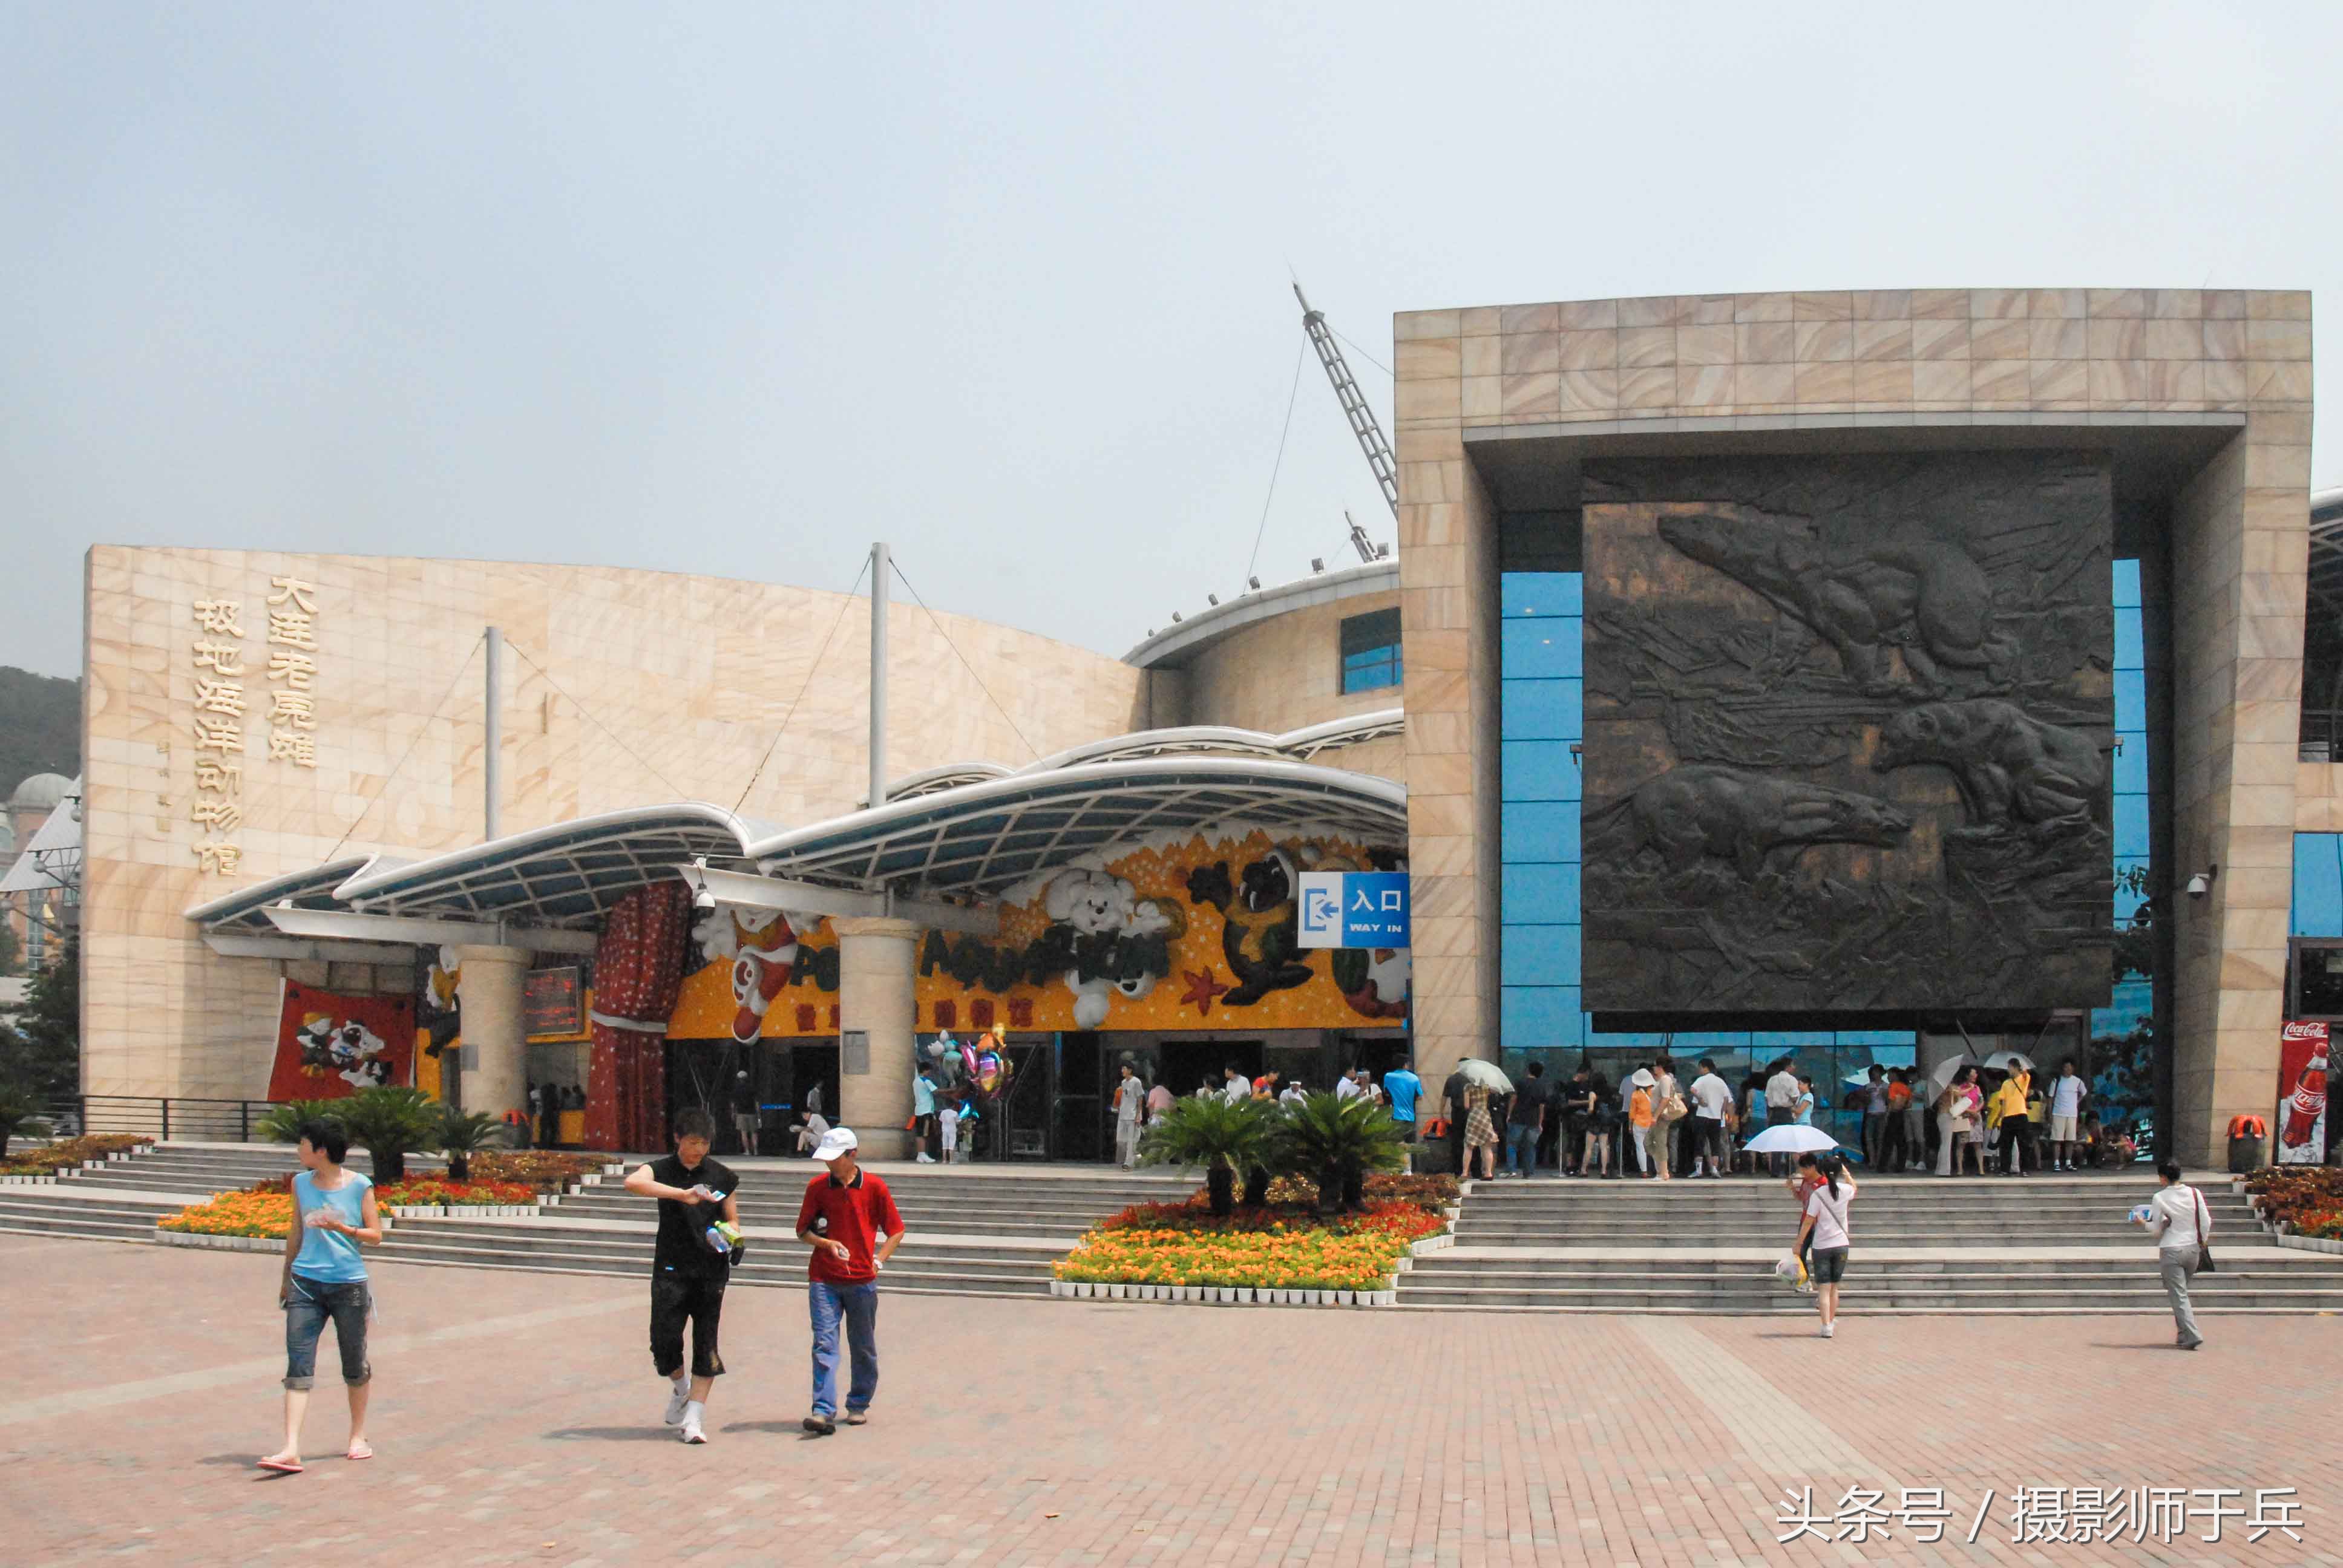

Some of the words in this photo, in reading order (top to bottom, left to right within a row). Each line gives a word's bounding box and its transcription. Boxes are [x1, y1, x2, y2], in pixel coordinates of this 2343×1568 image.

[267, 575, 320, 769] 大连老虎滩
[191, 596, 247, 877] 极地海洋动物馆
[1349, 923, 1380, 932] WAY
[1387, 924, 1402, 933] IN
[1351, 889, 1401, 912] 入口
